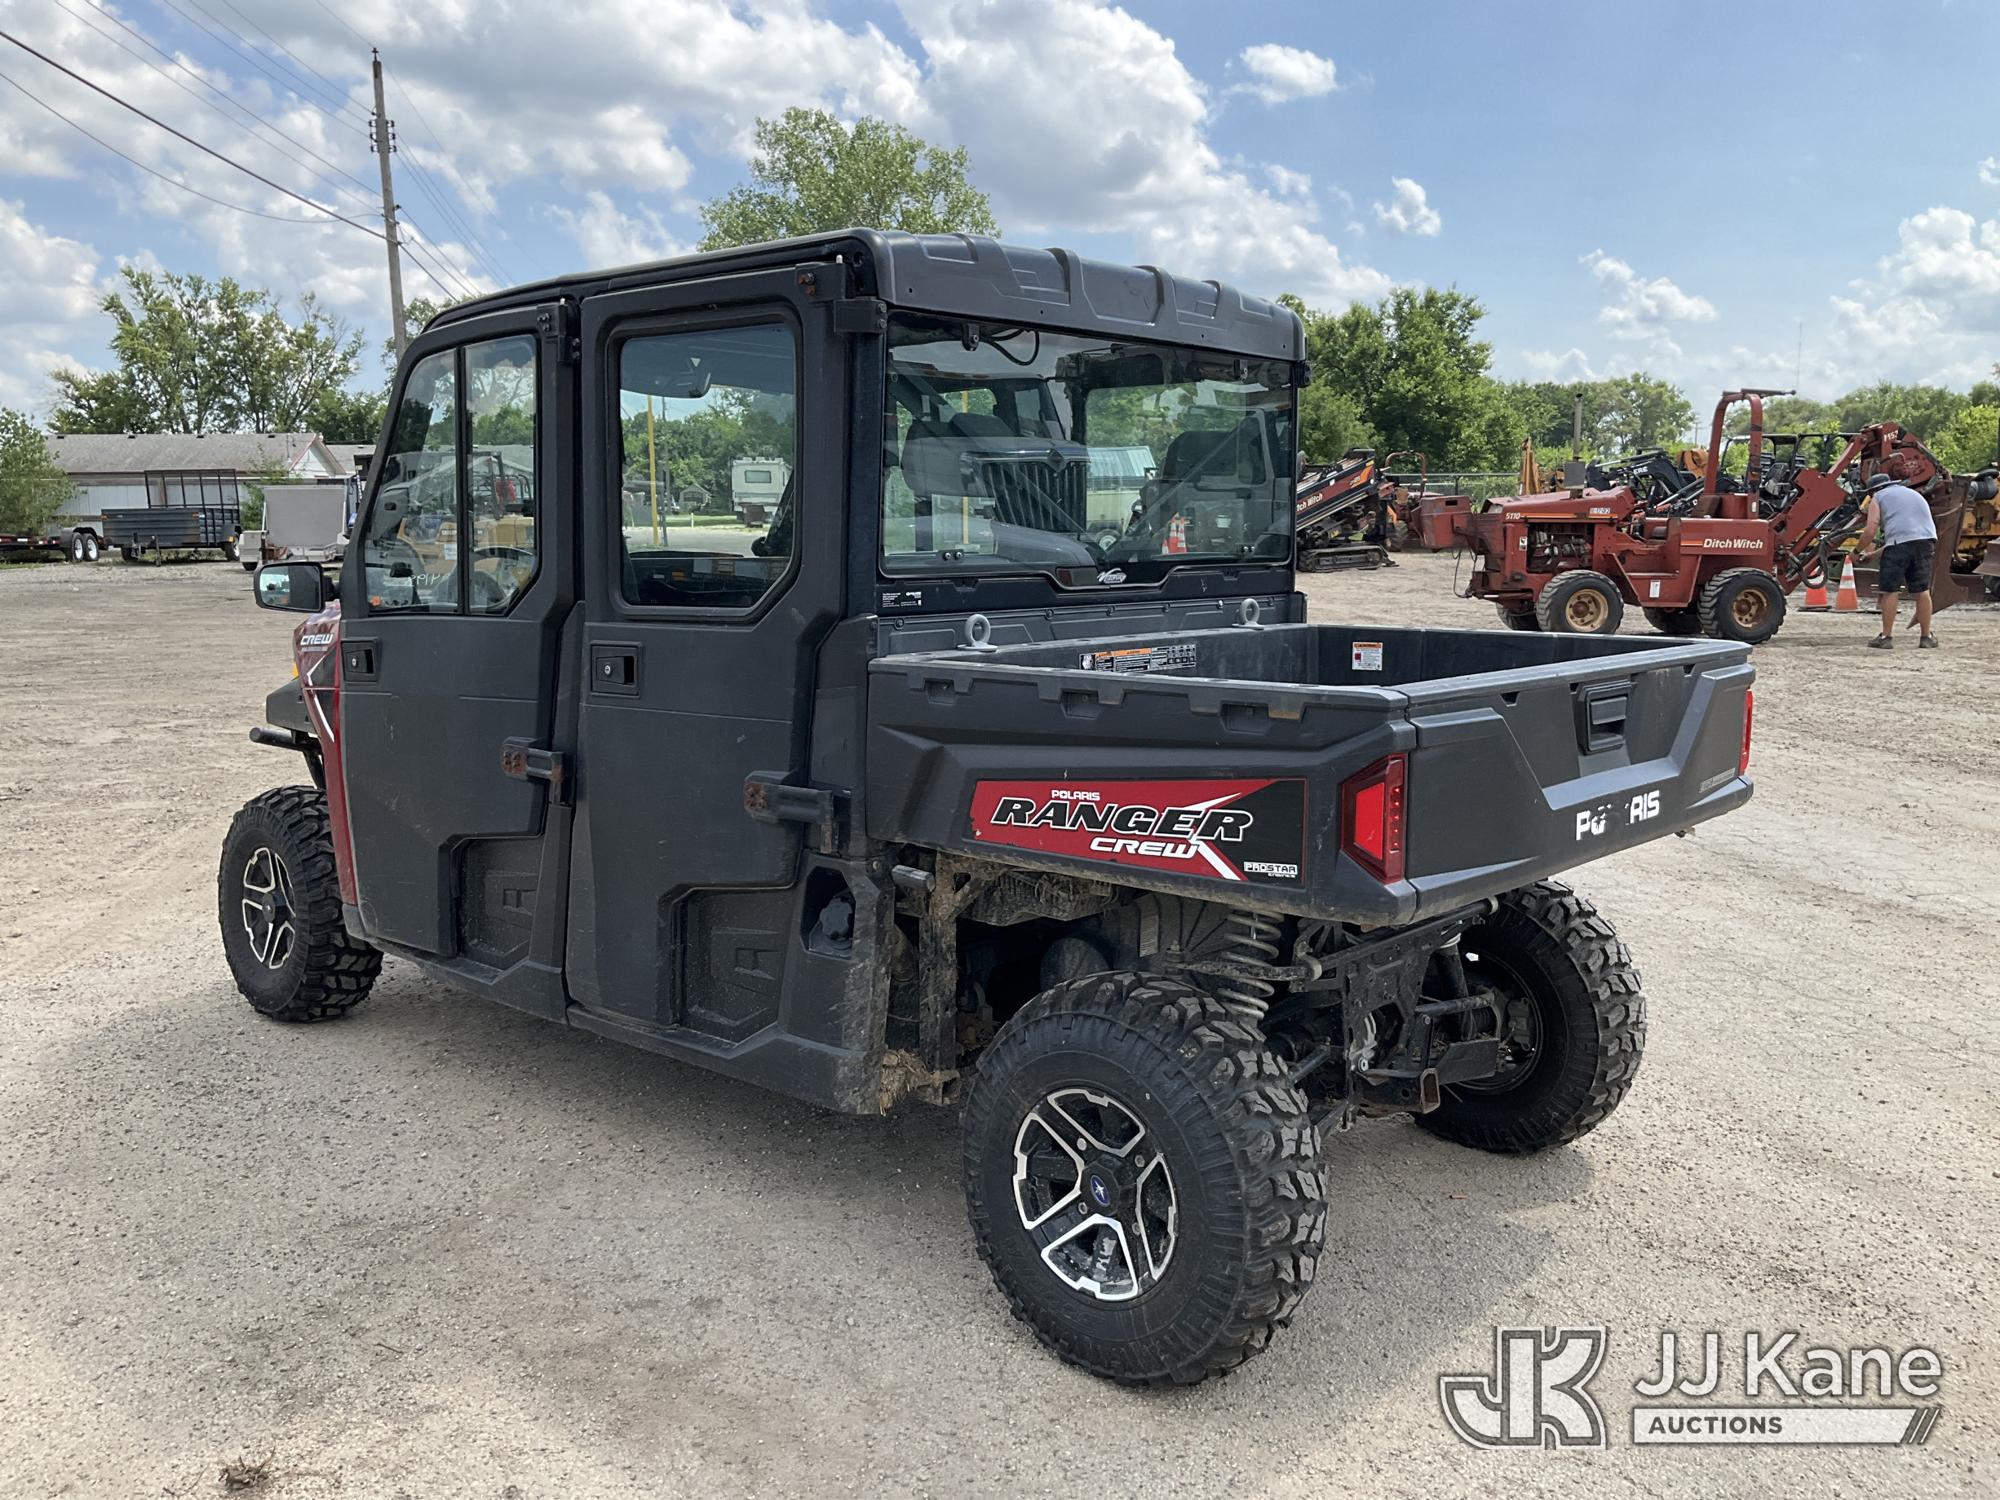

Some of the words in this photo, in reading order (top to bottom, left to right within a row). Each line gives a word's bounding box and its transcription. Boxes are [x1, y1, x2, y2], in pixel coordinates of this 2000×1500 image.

[1296, 500, 1307, 511] tch
[1505, 512, 1521, 520] 5110
[1703, 538, 1732, 548] Ditch
[1733, 538, 1763, 549] Witch
[300, 633, 333, 646] CREW
[1051, 789, 1100, 801] POLARIS
[990, 796, 1254, 842] RANGER
[1575, 789, 1660, 841] PORIS
[1090, 837, 1199, 860] CREW
[1245, 862, 1297, 875] PROSTAR
